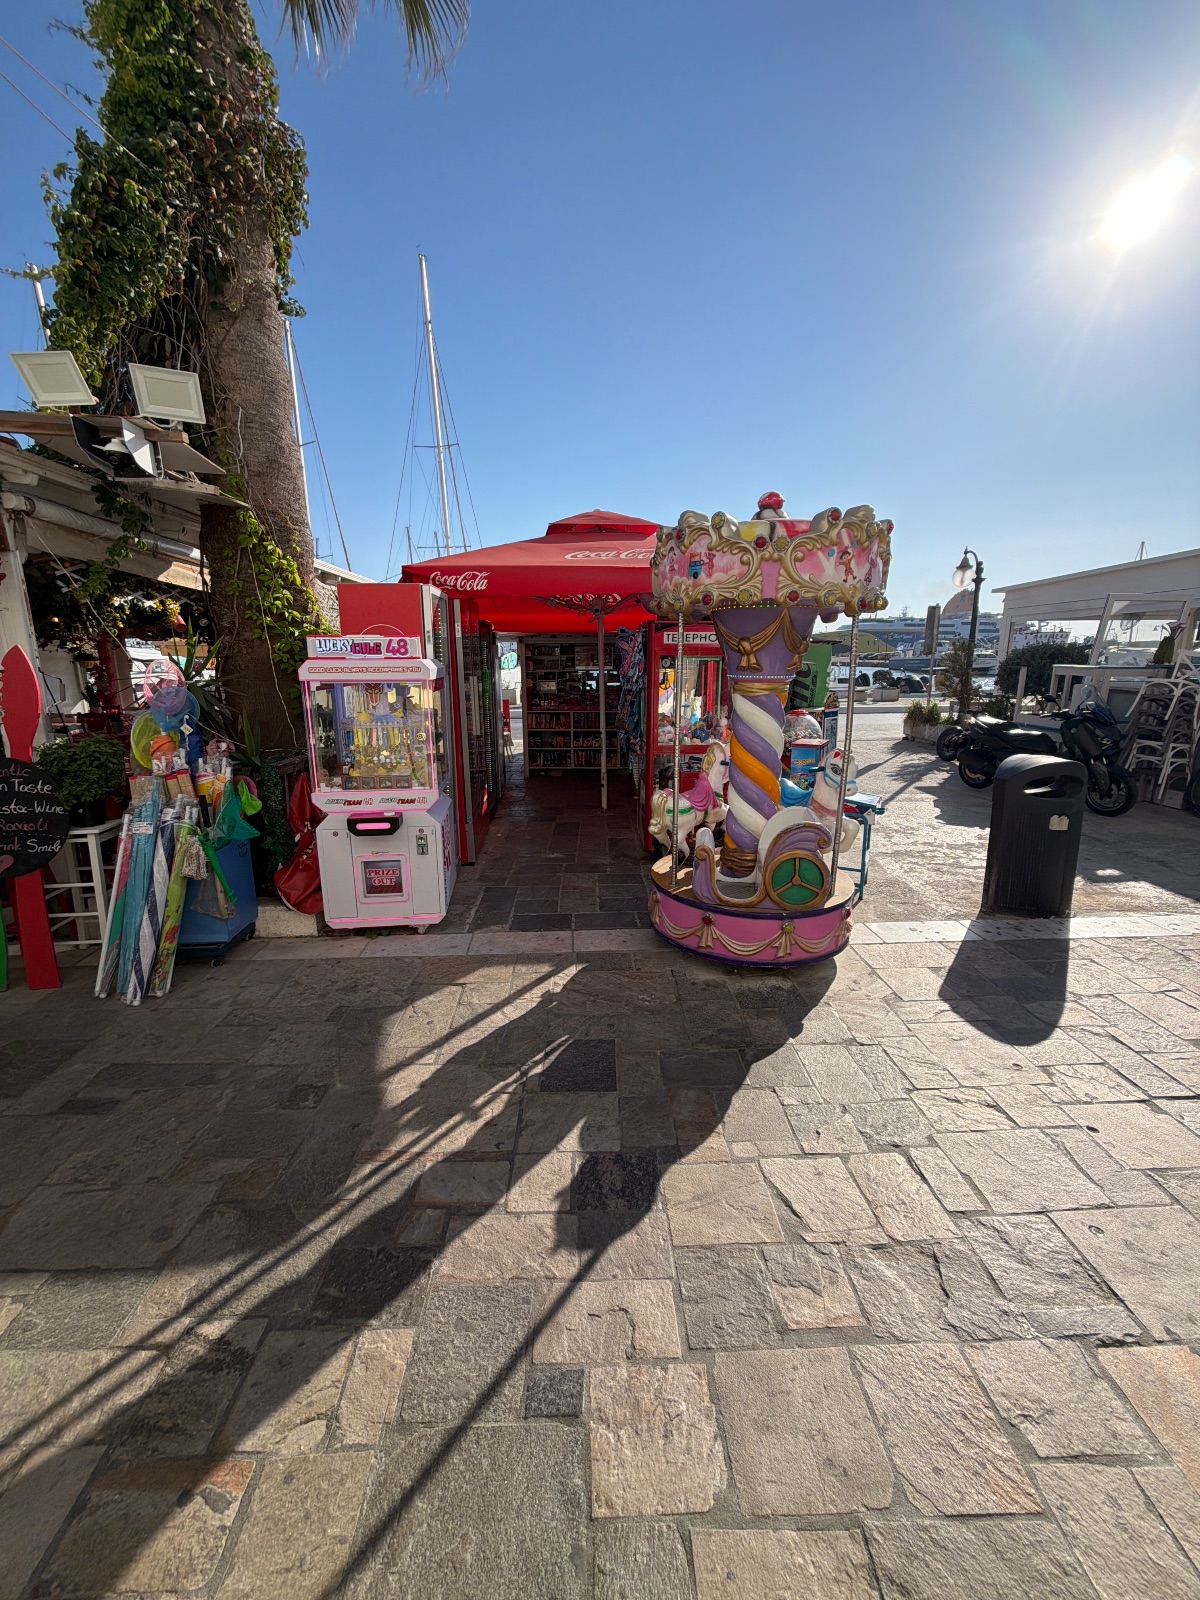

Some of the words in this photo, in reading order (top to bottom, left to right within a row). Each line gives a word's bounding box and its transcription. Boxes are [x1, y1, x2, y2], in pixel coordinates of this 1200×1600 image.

[429, 570, 491, 591] Coca-Cola
[665, 633, 717, 642] TEEPHO
[315, 638, 353, 653] LUCKY
[385, 637, 409, 656] 48
[0, 763, 31, 777] ntic
[10, 778, 53, 794] Taste
[366, 868, 399, 877] PRIZE
[371, 877, 395, 886] OUT
